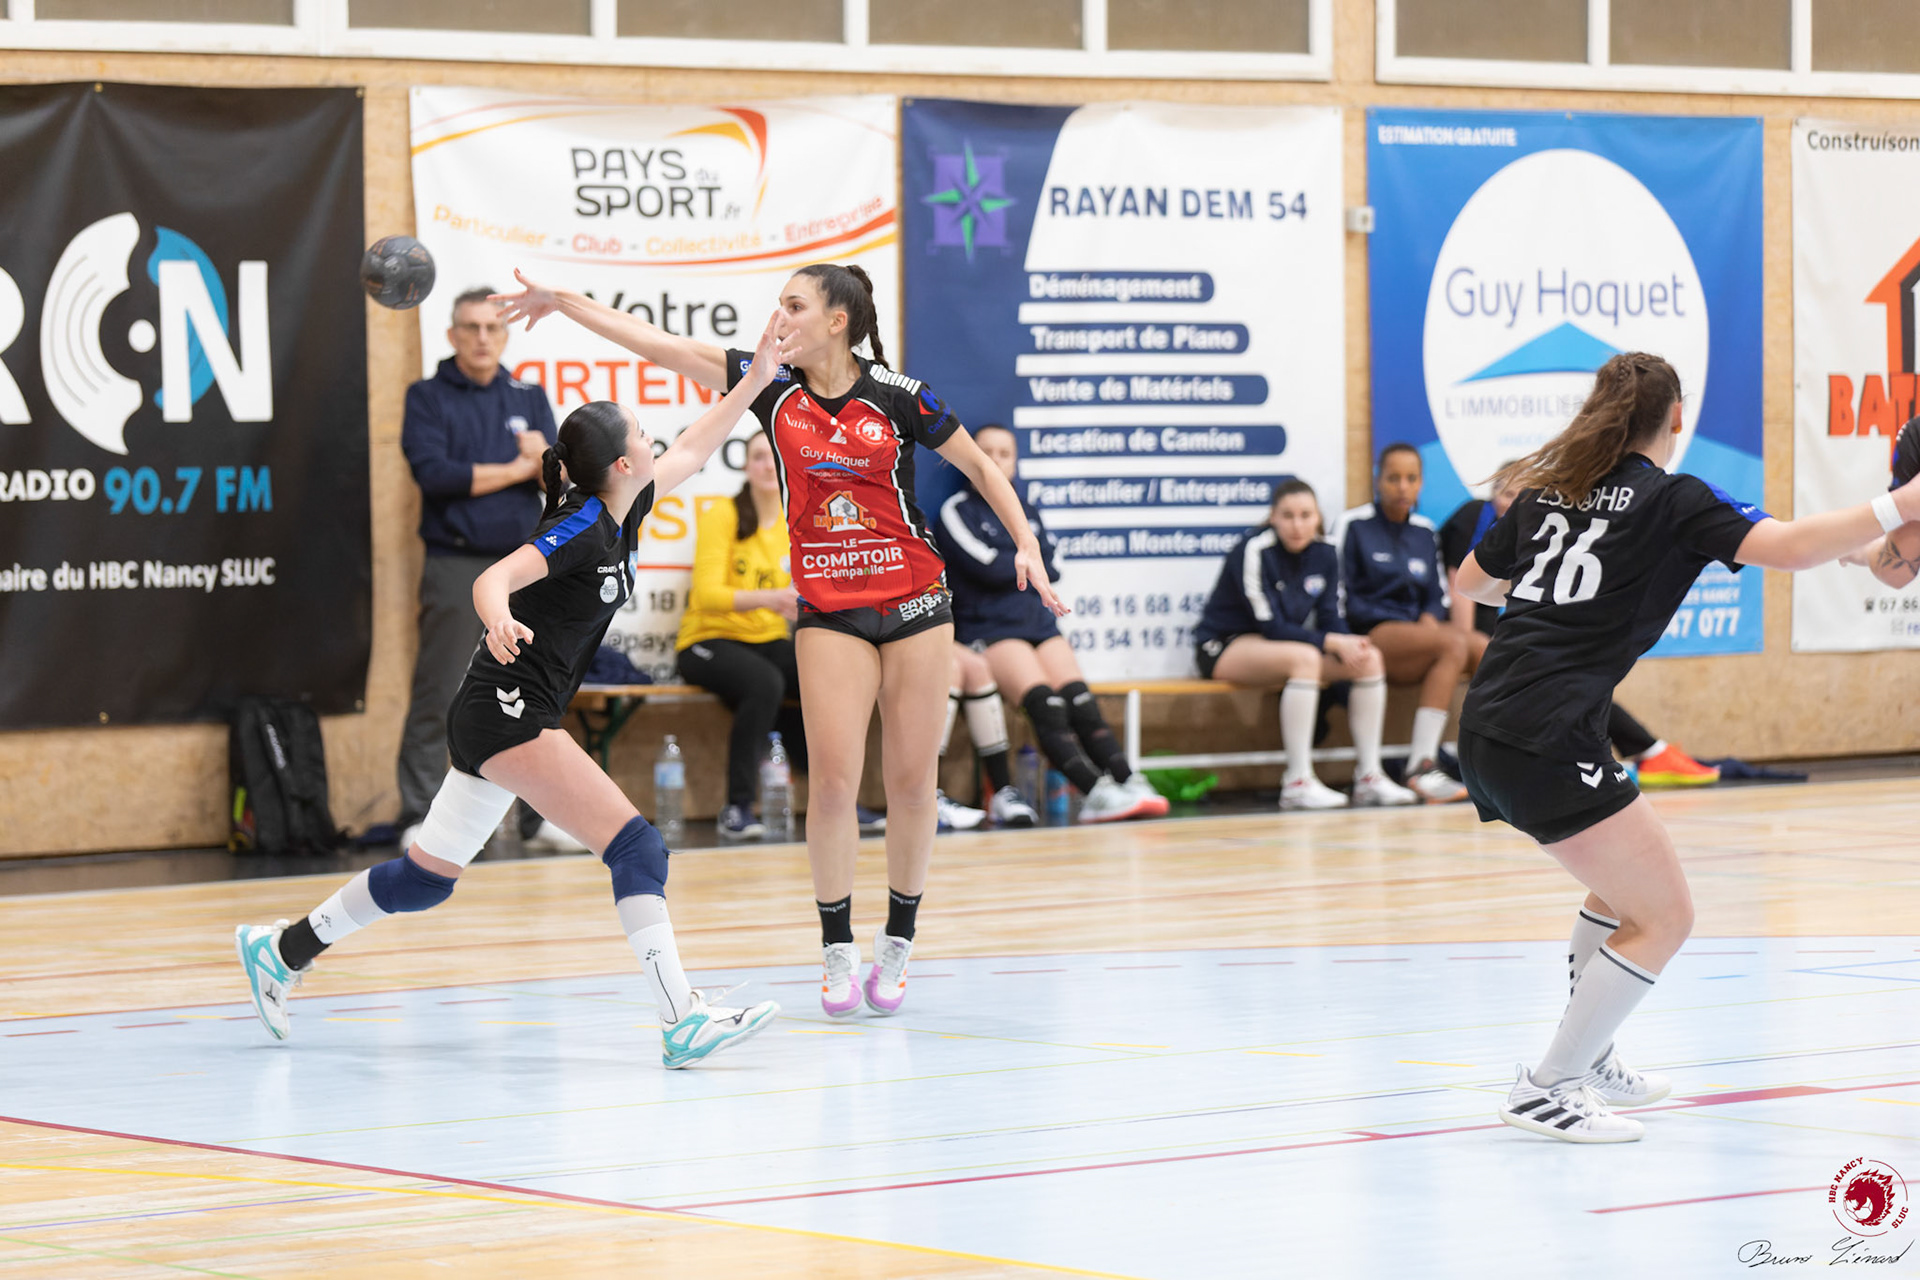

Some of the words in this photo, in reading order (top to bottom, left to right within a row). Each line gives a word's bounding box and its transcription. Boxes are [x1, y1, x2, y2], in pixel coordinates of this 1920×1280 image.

[1378, 125, 1454, 145] ESTIMATION
[1455, 127, 1517, 147] GRATUITE
[572, 148, 686, 181] PAYS
[1050, 186, 1168, 217] RAYAN
[1181, 190, 1254, 219] DEM
[1269, 191, 1308, 220] 54
[433, 203, 547, 247] Particulier
[572, 233, 622, 254] Club
[645, 228, 762, 256] Collectivité
[784, 195, 884, 243] Entreprise
[1029, 274, 1202, 302] Déménagement
[1445, 267, 1524, 327] Guy
[1537, 270, 1685, 326] Hoquet
[1030, 327, 1137, 354] Transport
[1139, 325, 1170, 349] de
[1173, 326, 1238, 350] Piano
[1030, 378, 1095, 402] Vente
[1100, 377, 1128, 400] de
[1130, 376, 1234, 401] Matériels
[1030, 430, 1126, 455] Location
[1128, 429, 1157, 453] de
[1160, 428, 1245, 453] Camion
[800, 446, 824, 461] Guy
[826, 451, 871, 468] Hoquet
[103, 466, 203, 515] 90.7
[215, 465, 273, 514] FM
[1028, 480, 1146, 506] Particulier
[1160, 478, 1270, 506] Entreprise
[843, 538, 858, 549] LE
[1055, 530, 1126, 557] cation
[802, 546, 904, 570] COMPTOIR
[823, 564, 885, 580] Campanile
[1511, 512, 1610, 606] 26
[52, 560, 85, 592] du
[89, 560, 139, 591] HBC
[143, 560, 218, 594] Nancy
[220, 556, 276, 588] SLUC
[898, 593, 933, 614] PAYS
